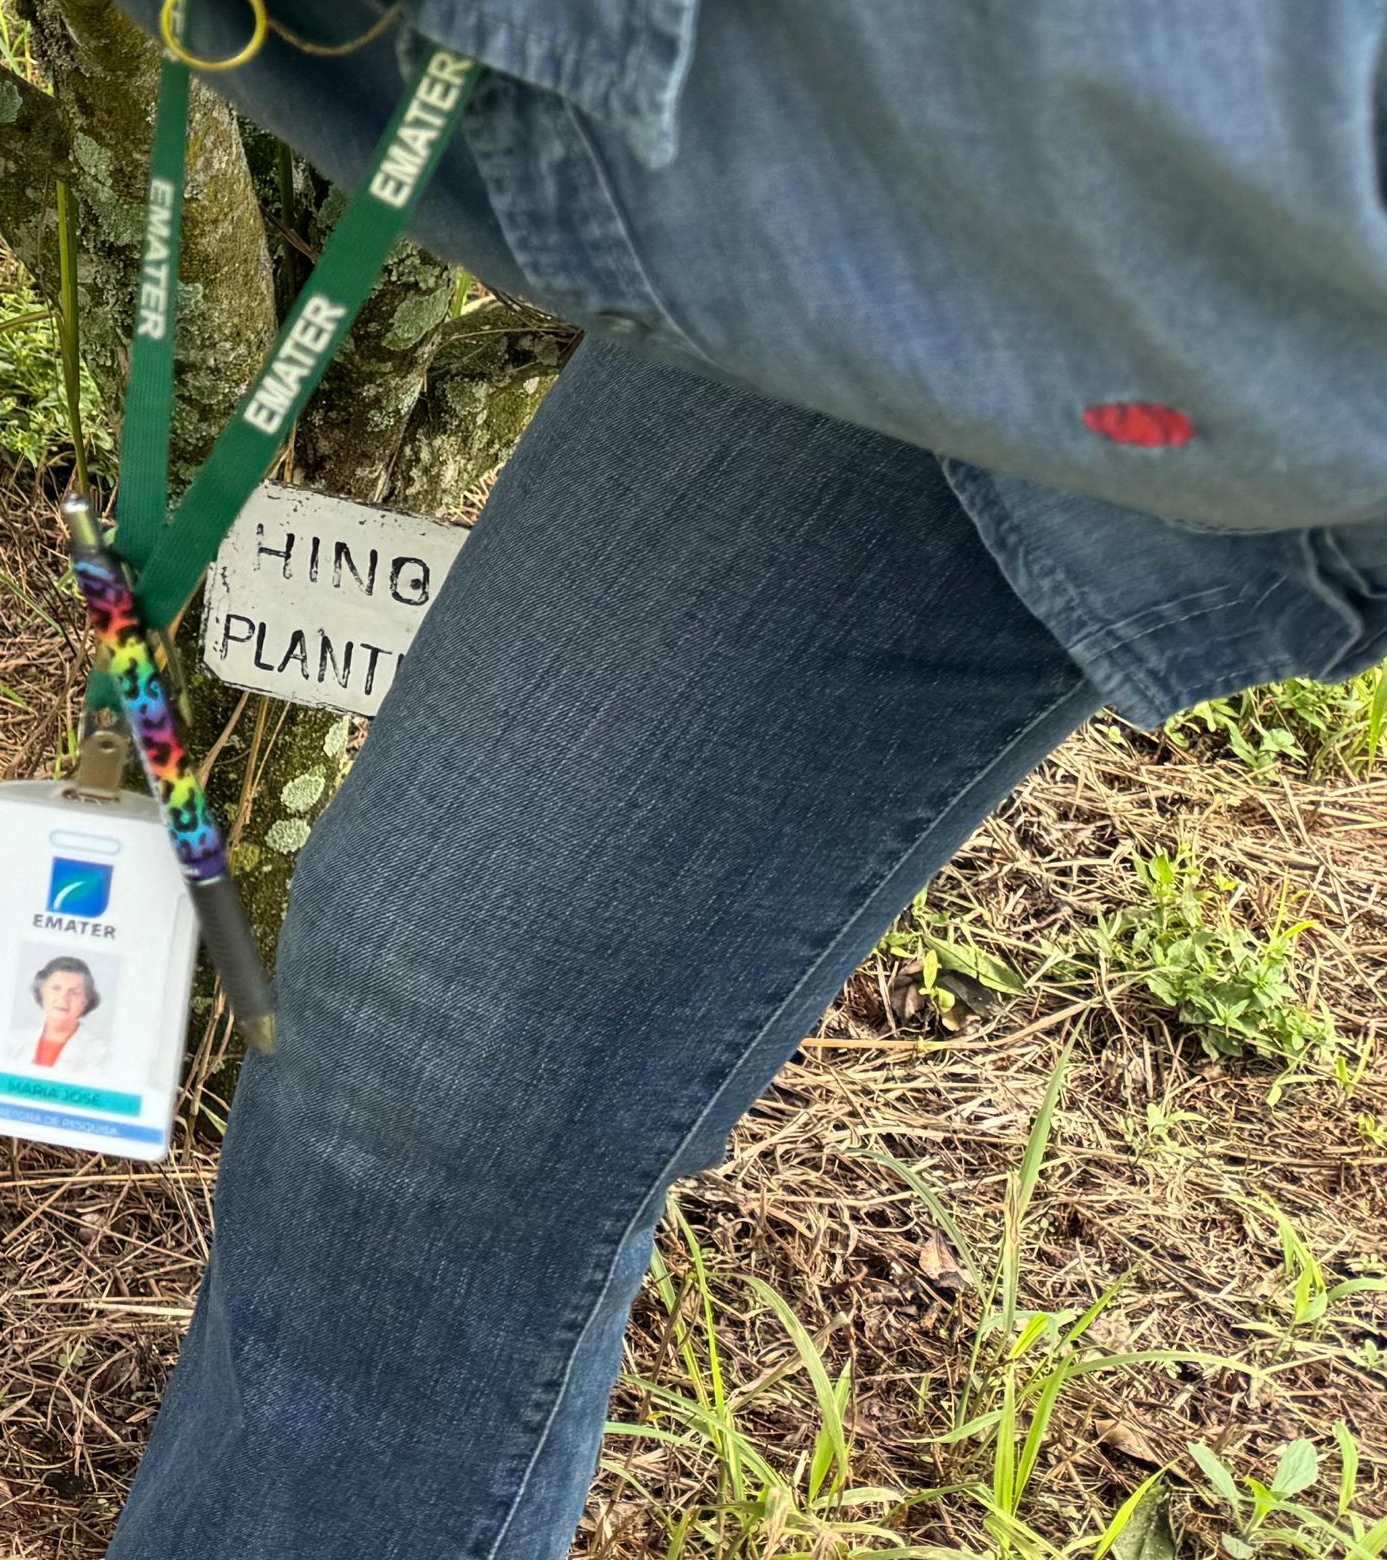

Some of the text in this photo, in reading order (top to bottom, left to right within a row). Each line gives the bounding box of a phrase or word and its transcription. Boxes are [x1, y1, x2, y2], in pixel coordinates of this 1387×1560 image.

[368, 51, 475, 209] EMATER
[138, 178, 175, 341] EMATER
[243, 294, 348, 436] EMATER
[220, 613, 405, 696] PLANT
[32, 913, 116, 939] EMATER
[7, 1080, 58, 1099] MARIA
